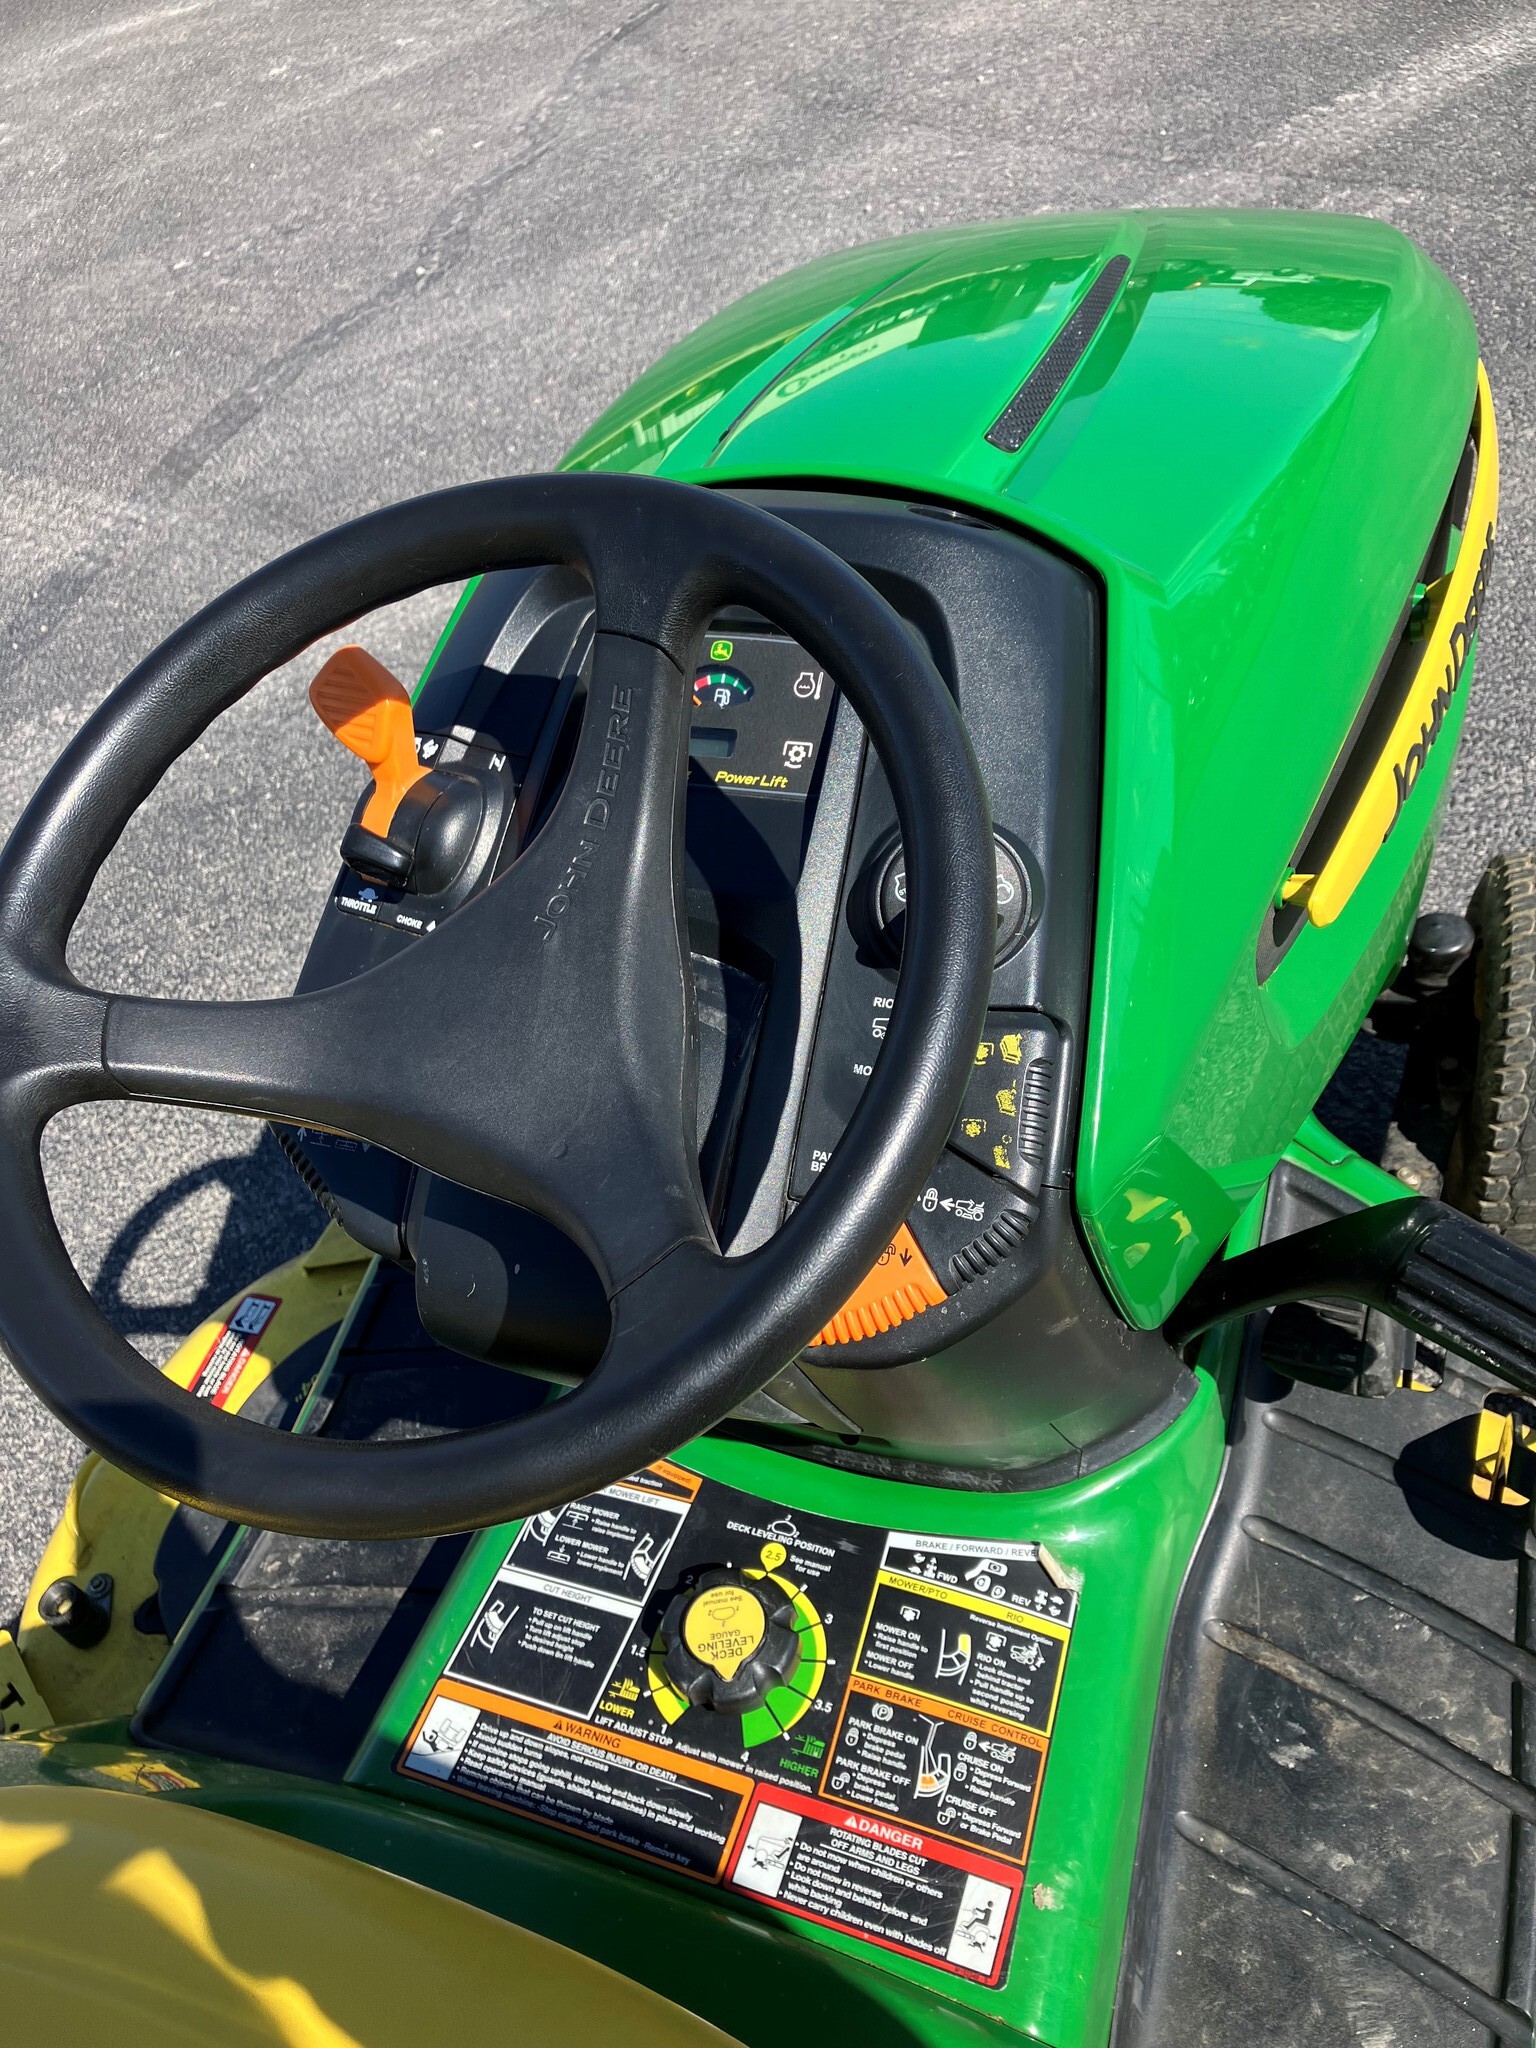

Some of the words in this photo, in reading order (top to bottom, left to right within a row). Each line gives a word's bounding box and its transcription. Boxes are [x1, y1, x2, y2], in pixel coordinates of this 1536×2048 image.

[1381, 664, 1454, 844] JOHN
[533, 839, 600, 940] JOHN
[583, 683, 633, 830] DEERE
[340, 896, 378, 915] THROTTLE
[396, 914, 423, 930] CHOKE
[608, 1487, 641, 1503] MOWER
[641, 1495, 660, 1508] LIFT
[554, 1534, 581, 1546] LOWER
[582, 1541, 608, 1553] MOWER
[726, 1520, 750, 1534] DECK
[751, 1526, 794, 1546] LEVELING
[794, 1539, 836, 1557] POSITION
[915, 1539, 947, 1550] BRAKE
[955, 1544, 1003, 1556] FORWARD
[1011, 1548, 1037, 1558] REVE
[765, 1550, 782, 1562] 2.5
[790, 1554, 803, 1564] See
[804, 1558, 832, 1572] manual
[685, 1575, 693, 1584] 2
[795, 1564, 806, 1573] for
[806, 1568, 821, 1577] use
[936, 1571, 957, 1583] FWD
[543, 1583, 560, 1593] CUT
[561, 1589, 591, 1604] HEIGHT
[889, 1576, 947, 1598] MOWER/PTO
[1011, 1594, 1030, 1606] REV
[533, 1606, 543, 1615] TO
[543, 1610, 557, 1619] SET
[557, 1614, 573, 1623] CUT
[573, 1619, 599, 1631] HEIGHT
[824, 1613, 834, 1625] 3
[1006, 1611, 1023, 1623] RIO
[710, 1629, 741, 1640] GAUGE
[875, 1622, 906, 1636] MOWER
[907, 1632, 920, 1641] ON
[631, 1644, 647, 1658] 1.5
[697, 1635, 754, 1652] LEVELING
[711, 1647, 743, 1660] DECK
[866, 1650, 896, 1664] MOWER
[897, 1660, 913, 1669] OFF
[976, 1652, 992, 1662] RIO
[993, 1658, 1006, 1667] ON
[853, 1679, 880, 1694] PARK
[885, 1689, 921, 1707] BRAKE
[599, 1700, 634, 1717] LOWER
[814, 1699, 833, 1713] 3.5
[566, 1723, 620, 1747] WARNING
[594, 1714, 614, 1726] LIFT
[613, 1721, 647, 1737] ADJUST
[648, 1732, 672, 1745] STOP
[661, 1724, 668, 1734] 1
[848, 1717, 871, 1730] PARK
[873, 1725, 903, 1740] BRAKE
[904, 1735, 918, 1745] ON
[947, 1709, 985, 1728] CRUISE
[991, 1724, 1041, 1748] CONTROL
[547, 1733, 570, 1746] AVOID
[571, 1741, 605, 1757] SERIOUS
[606, 1752, 634, 1766] INJURY
[635, 1762, 648, 1772] OR
[649, 1766, 676, 1781] DEATH
[741, 1751, 750, 1763] 4
[957, 1752, 988, 1768] CRUISE
[989, 1763, 1003, 1773] ON
[779, 1757, 820, 1779] HIGHER
[835, 1756, 859, 1770] PARK
[860, 1764, 890, 1780] BRAKE
[892, 1774, 910, 1785] OFF
[945, 1794, 977, 1811] CRUISE
[978, 1805, 996, 1816] OFF
[859, 1819, 922, 1849] DANGER
[830, 1827, 870, 1847] ROTATING
[872, 1842, 907, 1859] BLADES
[908, 1854, 927, 1866] CUT
[830, 1838, 849, 1849] OFF
[849, 1845, 874, 1859] ARMS
[875, 1854, 894, 1866] AND
[895, 1861, 919, 1875] LEGS
[796, 1853, 810, 1862] are
[811, 1858, 839, 1872] around
[799, 1841, 812, 1852] Do
[812, 1848, 826, 1857] not
[827, 1853, 847, 1864] mow
[848, 1860, 870, 1872] when
[871, 1868, 903, 1884] children
[916, 1884, 942, 1898] others
[793, 1861, 806, 1871] Do
[806, 1867, 821, 1877] not
[821, 1872, 841, 1883] mow
[842, 1878, 851, 1887] in
[851, 1883, 881, 1898] reverse
[786, 1882, 809, 1895] while
[810, 1889, 842, 1907] backing
[790, 1871, 811, 1884] Look
[812, 1880, 834, 1892] down
[835, 1888, 851, 1898] and
[852, 1893, 881, 1909] behind
[881, 1903, 908, 1919] before
[910, 1915, 927, 1925] and
[783, 1890, 807, 1904] Never
[807, 1901, 829, 1913] carry
[830, 1909, 862, 1925] children
[863, 1921, 884, 1933] even
[885, 1928, 903, 1940] with
[904, 1934, 932, 1951] blades
[933, 1946, 946, 1955] off
